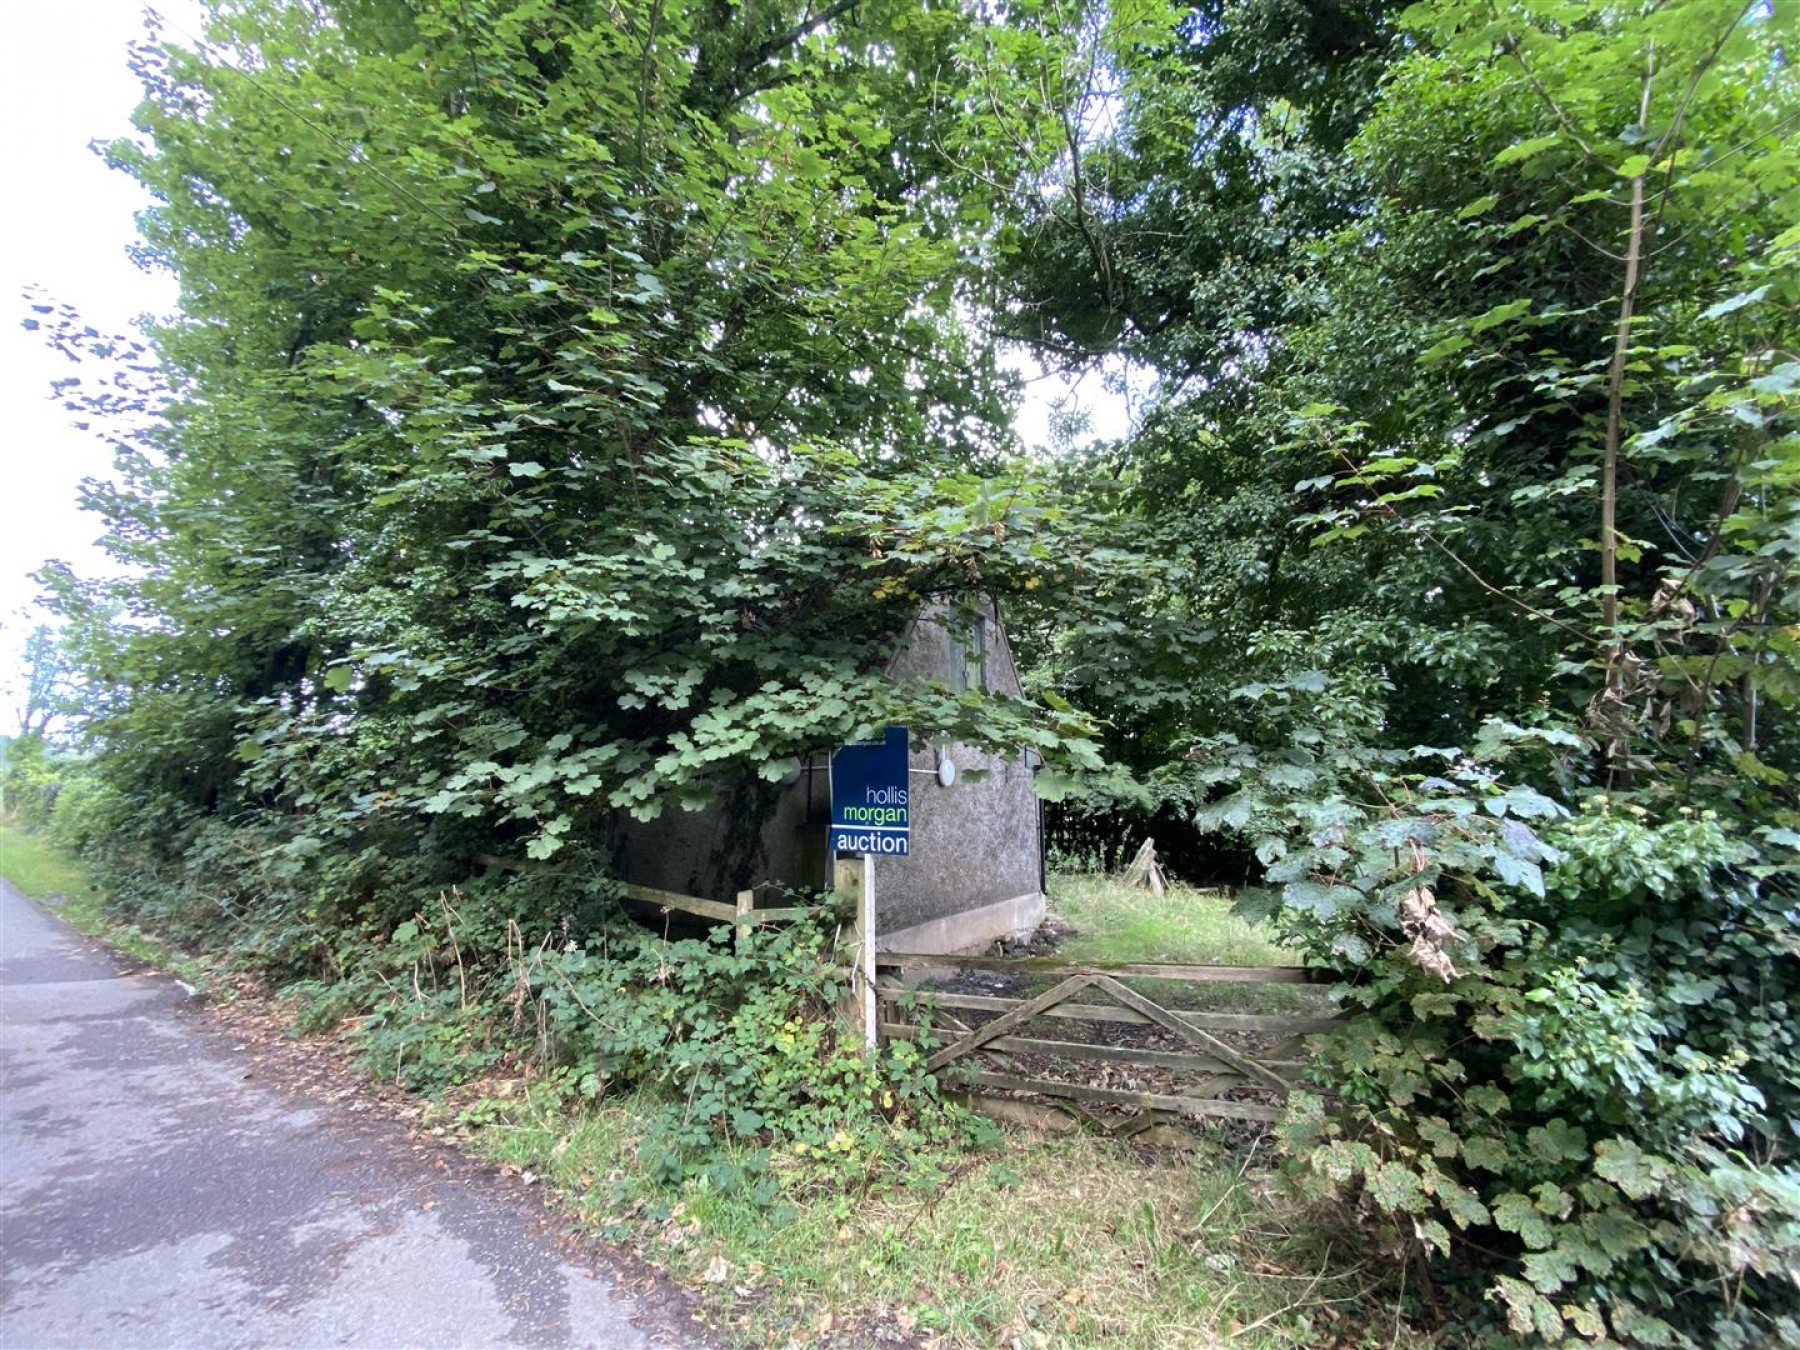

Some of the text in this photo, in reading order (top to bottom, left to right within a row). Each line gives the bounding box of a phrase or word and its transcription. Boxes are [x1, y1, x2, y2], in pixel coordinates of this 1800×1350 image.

[866, 785, 907, 805] hollis
[844, 806, 907, 826] morgan
[837, 832, 907, 853] auction
